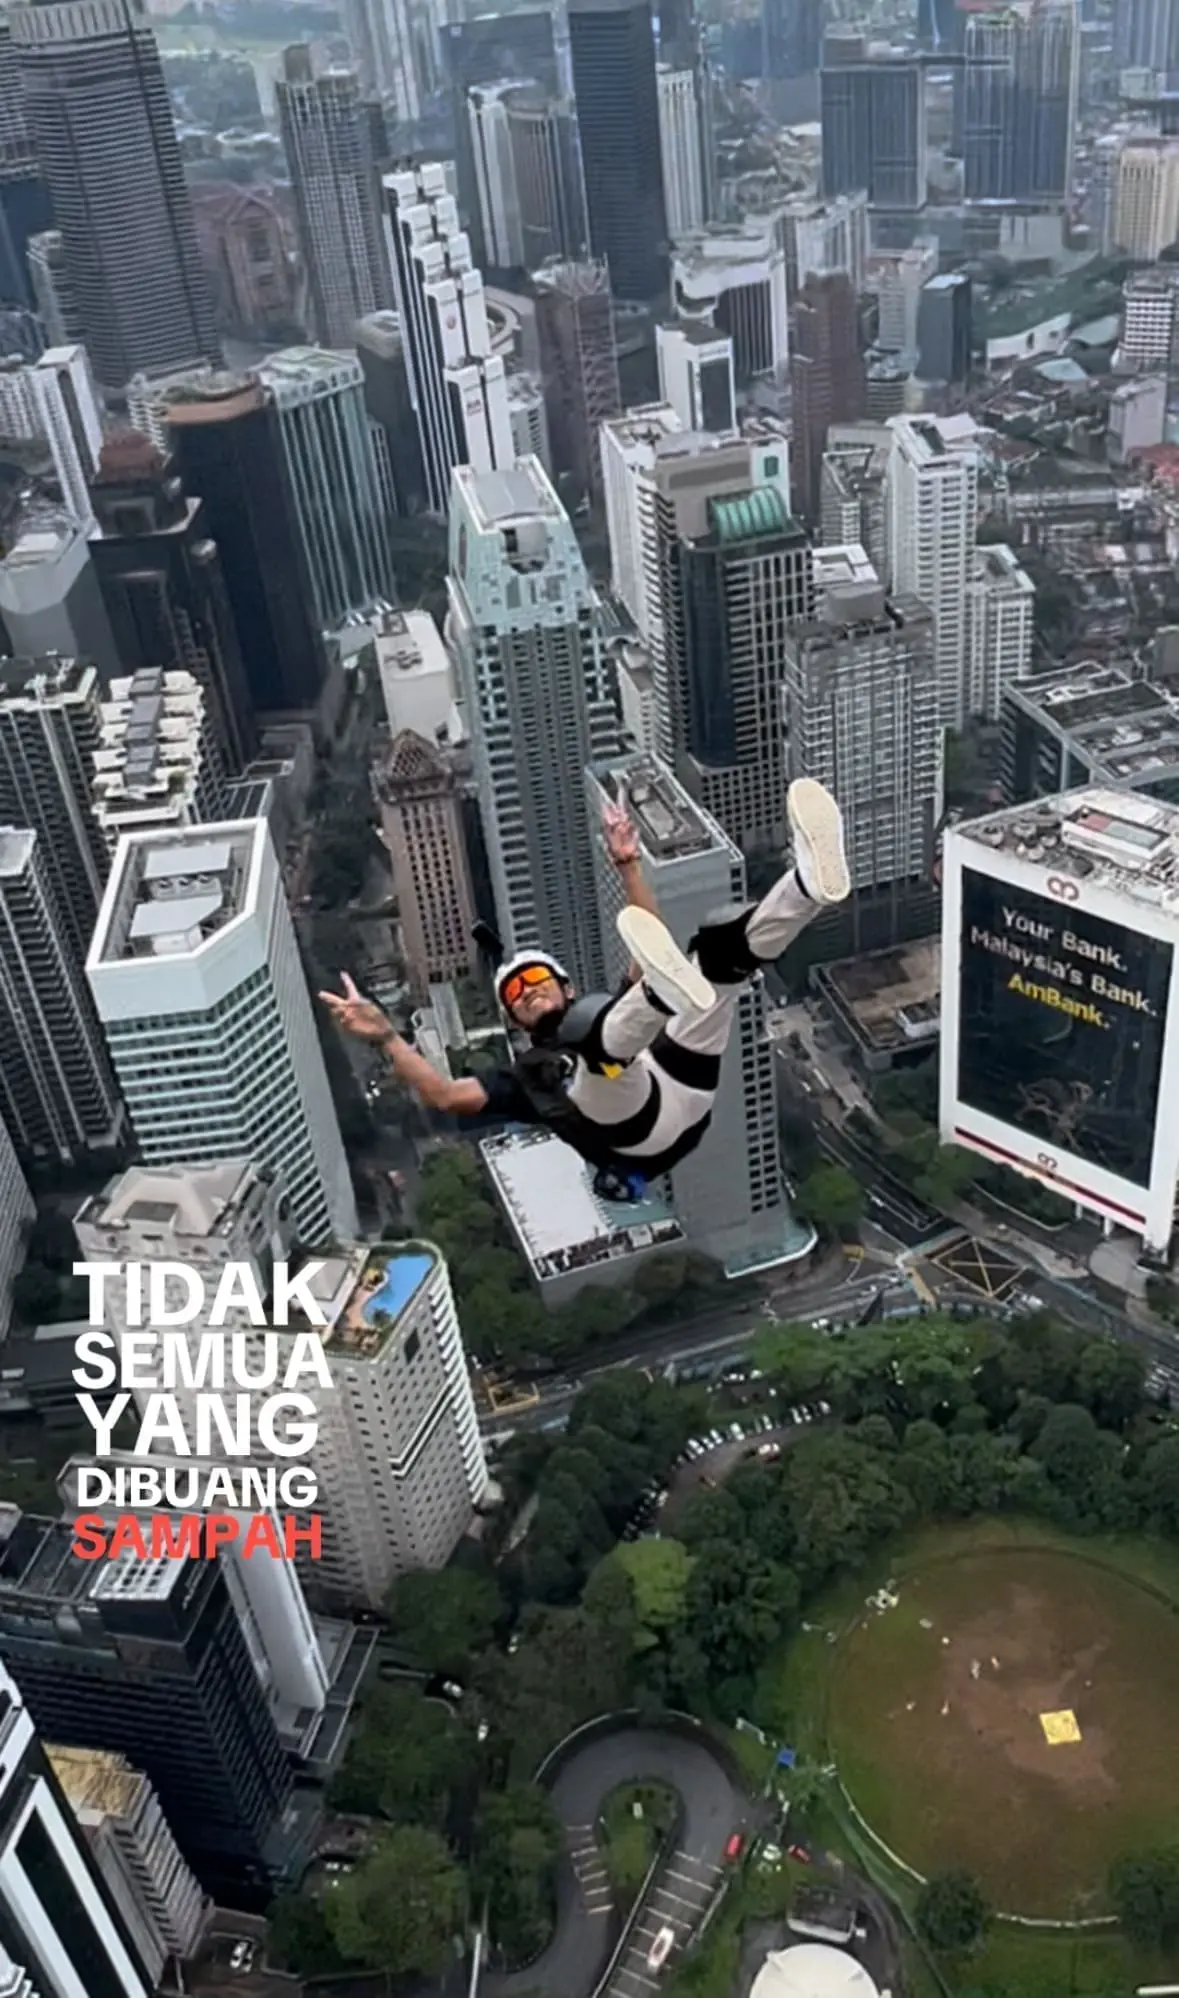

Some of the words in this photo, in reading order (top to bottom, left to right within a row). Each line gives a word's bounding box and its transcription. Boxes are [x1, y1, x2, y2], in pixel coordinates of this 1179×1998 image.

[971, 926, 1084, 985] Malaysia's
[1091, 974, 1158, 1017] Bank.
[1002, 906, 1054, 940] Your
[1061, 931, 1128, 972] Bank.
[1007, 972, 1111, 1029] AmBank.
